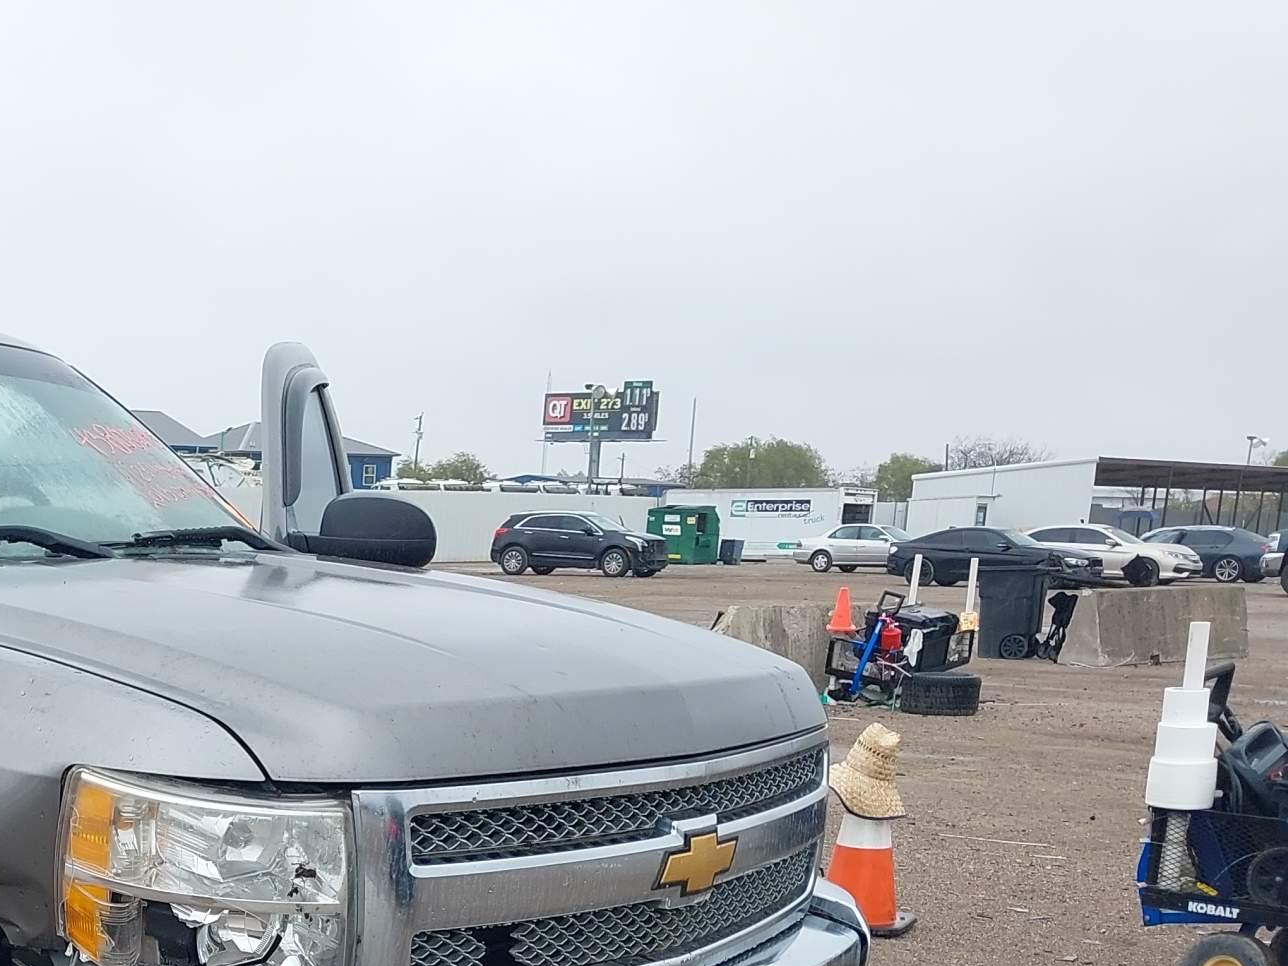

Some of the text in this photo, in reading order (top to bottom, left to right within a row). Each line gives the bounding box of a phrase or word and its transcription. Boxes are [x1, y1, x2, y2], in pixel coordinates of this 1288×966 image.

[548, 400, 568, 419] QT
[599, 398, 621, 410] 273
[747, 500, 810, 512] Enterprise
[1187, 901, 1241, 919] KOBALT
